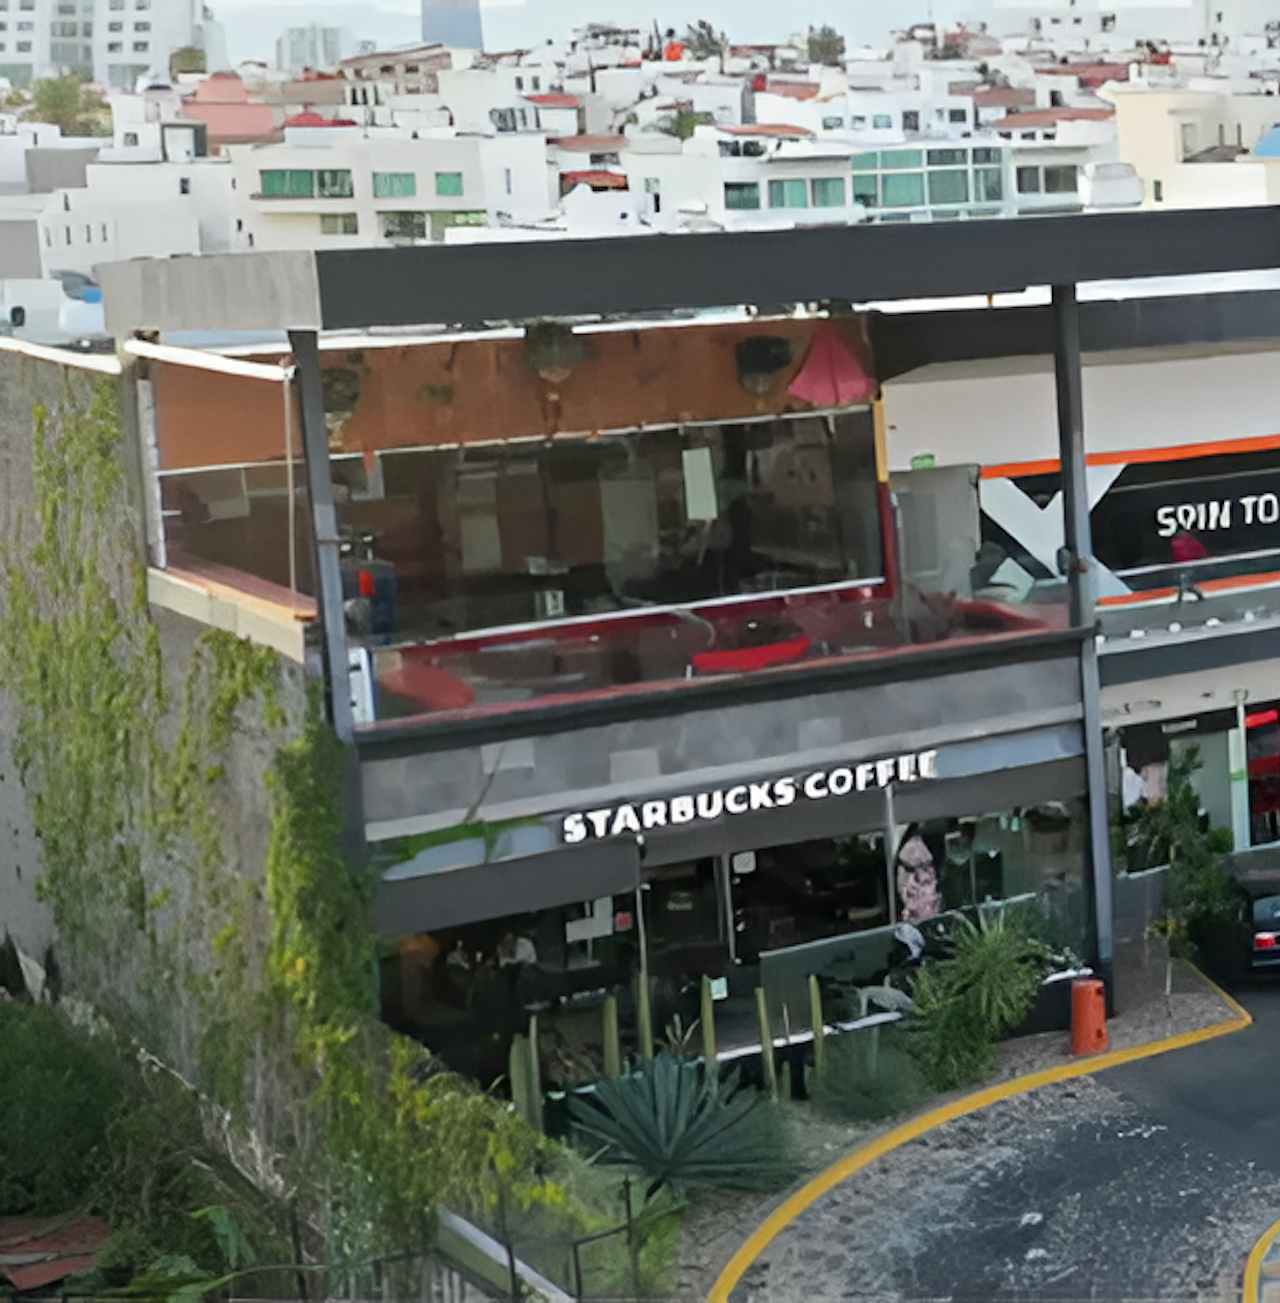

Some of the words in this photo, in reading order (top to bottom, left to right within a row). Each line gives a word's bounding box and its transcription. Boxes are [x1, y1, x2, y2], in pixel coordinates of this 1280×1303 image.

[1156, 500, 1231, 537] SPIN
[1240, 493, 1280, 524] TO
[562, 775, 796, 844] STARBUCKS
[803, 749, 938, 800] COFFEE
